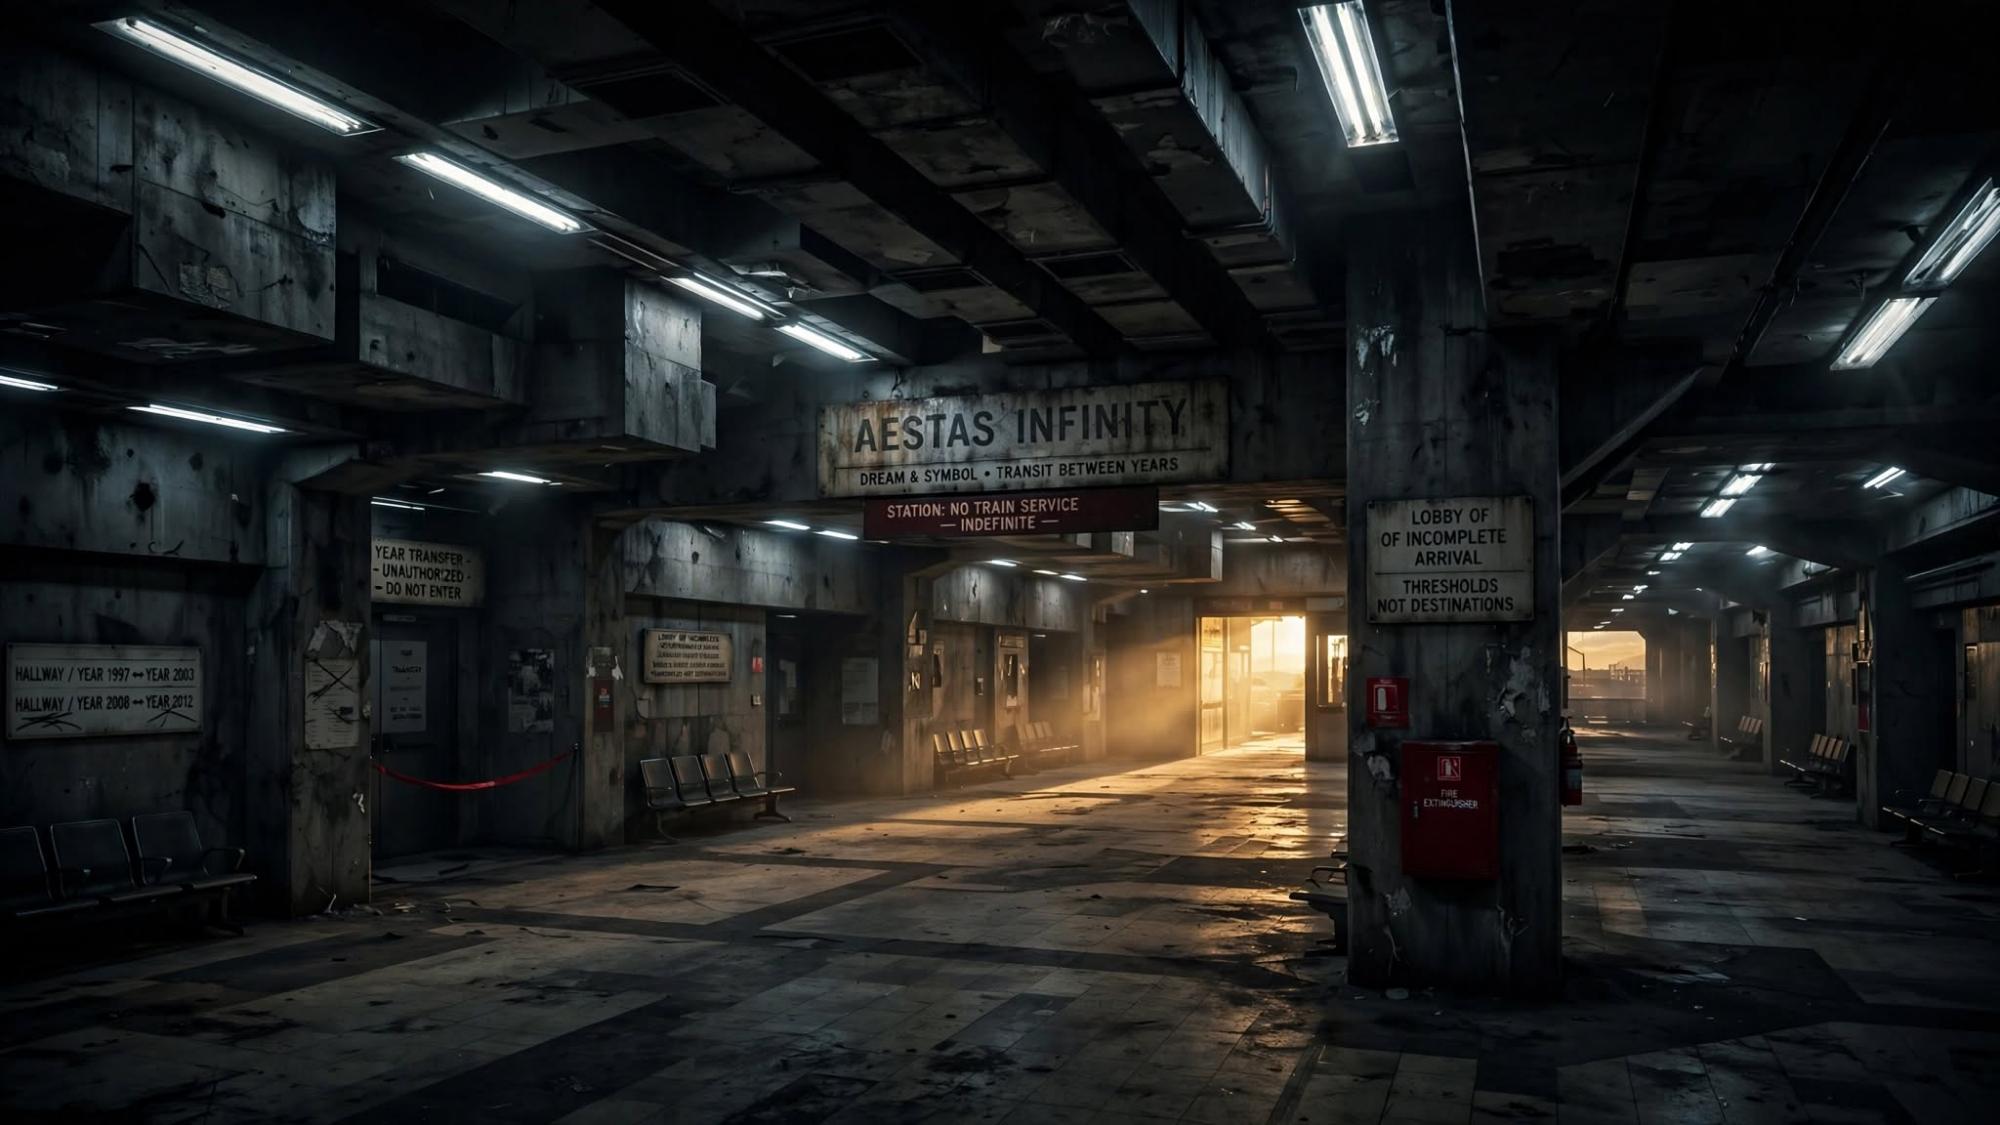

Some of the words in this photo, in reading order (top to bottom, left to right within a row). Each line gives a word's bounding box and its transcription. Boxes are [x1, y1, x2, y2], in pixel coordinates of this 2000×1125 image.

[854, 411, 995, 452] AESTAS
[1017, 399, 1186, 443] INFINITY
[860, 471, 905, 486] DREAM
[910, 470, 918, 483] &
[924, 468, 977, 482] SYMBOL
[996, 464, 1053, 479] TRANSIT
[1059, 460, 1125, 477] BETWEEN
[1131, 457, 1178, 473] YEARS
[887, 503, 945, 519] STATION:
[950, 502, 969, 516] NO
[974, 500, 1015, 515] TRAIN
[1020, 497, 1080, 513] SERVICE
[1412, 508, 1463, 525] LOBBY
[1469, 508, 1489, 523] OF
[961, 515, 1036, 532] INDEFINITE
[1381, 532, 1400, 547] OF
[1406, 528, 1507, 546] INCOMPLETE
[375, 545, 405, 560] YEAR
[409, 548, 463, 566] TRANSFER
[1415, 550, 1483, 566] ARRIVAL
[382, 563, 464, 583] UNAUTHORIZED
[386, 582, 402, 595] DO
[405, 583, 425, 597] NOT
[430, 585, 461, 599] ENTER
[1403, 578, 1498, 594] THRESHOLDS
[1377, 599, 1406, 613] NOT
[1411, 597, 1514, 612] DESTINATIONS
[16, 666, 64, 682] HALLWAY
[77, 667, 103, 681] YEAR
[108, 667, 130, 681] 1997
[146, 667, 170, 681] YEAR
[173, 668, 195, 681] 2003
[16, 696, 64, 712] HALLWAY
[77, 696, 103, 710] YEAR
[106, 695, 130, 709] 2008
[146, 695, 169, 709] YEAR
[173, 695, 193, 708] 2012
[1440, 788, 1458, 799] FIRE
